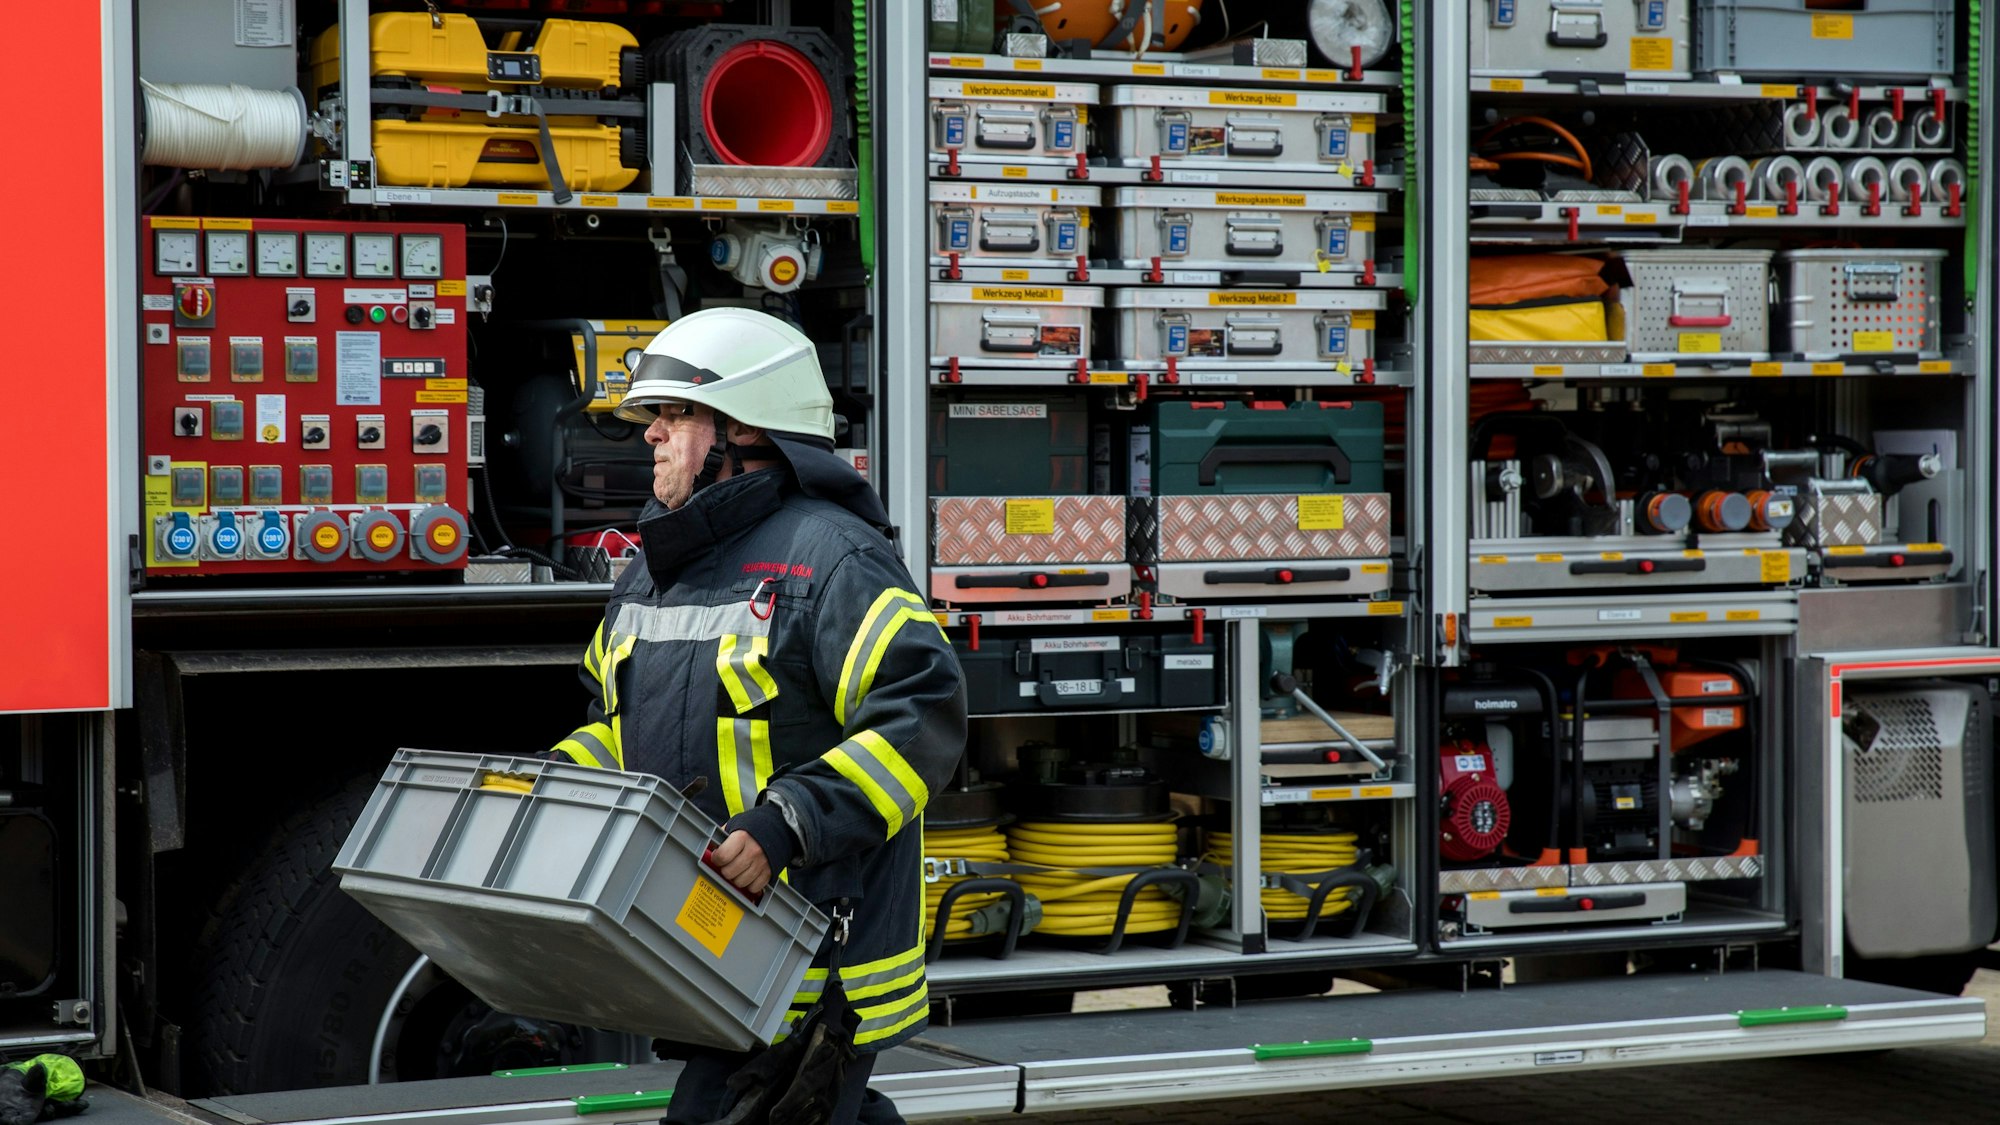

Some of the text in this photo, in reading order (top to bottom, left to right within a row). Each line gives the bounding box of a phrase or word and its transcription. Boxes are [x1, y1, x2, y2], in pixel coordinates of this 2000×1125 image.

[1182, 67, 1206, 75] Ebene
[969, 86, 1048, 97] Verbrauchsmaterial
[1224, 93, 1282, 104] Werkzeug Holz
[386, 192, 412, 201] Ebene
[988, 190, 1040, 199] Aufzugstasche
[1217, 195, 1304, 205] Werkzeugkasten Hazet
[982, 288, 1022, 300] Werkzeug
[1024, 288, 1048, 298] Metall
[1218, 294, 1256, 304] Werkzeug
[1258, 294, 1281, 302] Metall
[742, 562, 813, 578] FEUERWEHR KÖLN
[1007, 613, 1072, 622] Akku Bohrhammer
[1044, 640, 1108, 649] Akku Bohrhammer
[1474, 700, 1518, 709] holmatro
